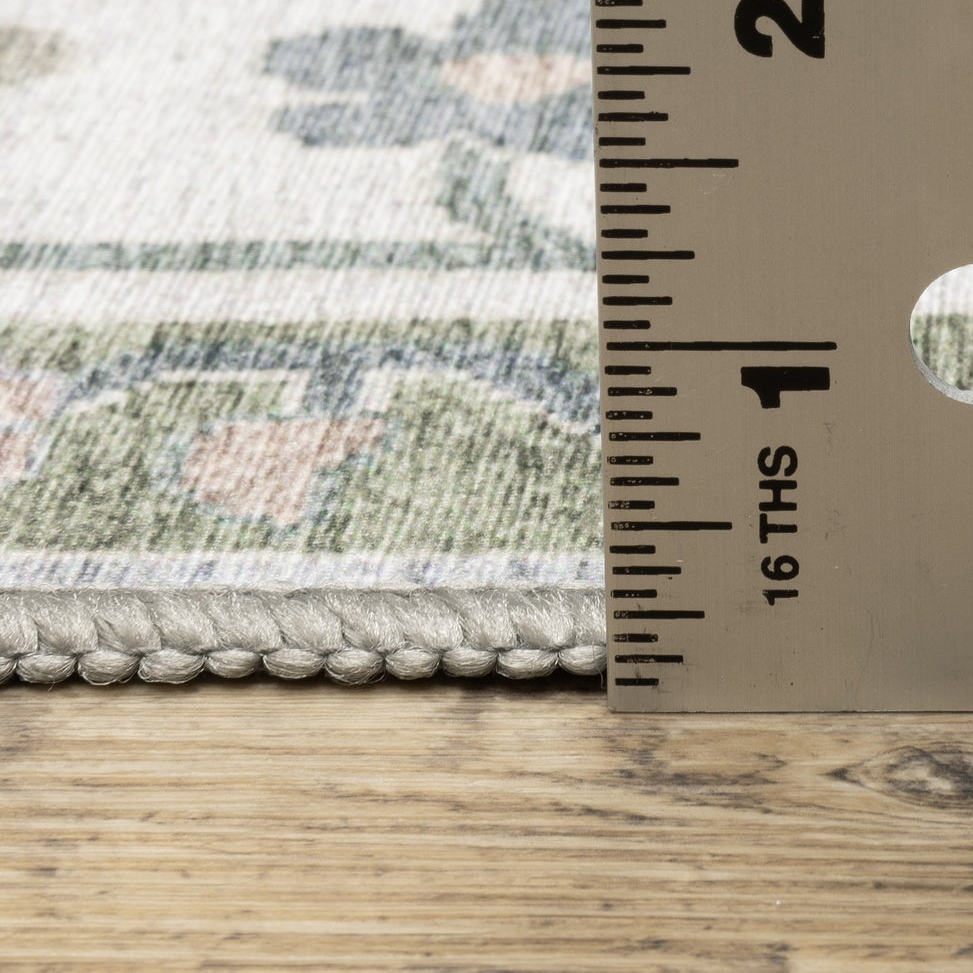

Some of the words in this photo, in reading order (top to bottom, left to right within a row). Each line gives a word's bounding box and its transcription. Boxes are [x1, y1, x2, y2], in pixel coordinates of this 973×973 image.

[740, 366, 831, 410] 1
[757, 445, 798, 544] THS
[760, 554, 800, 606] 16
